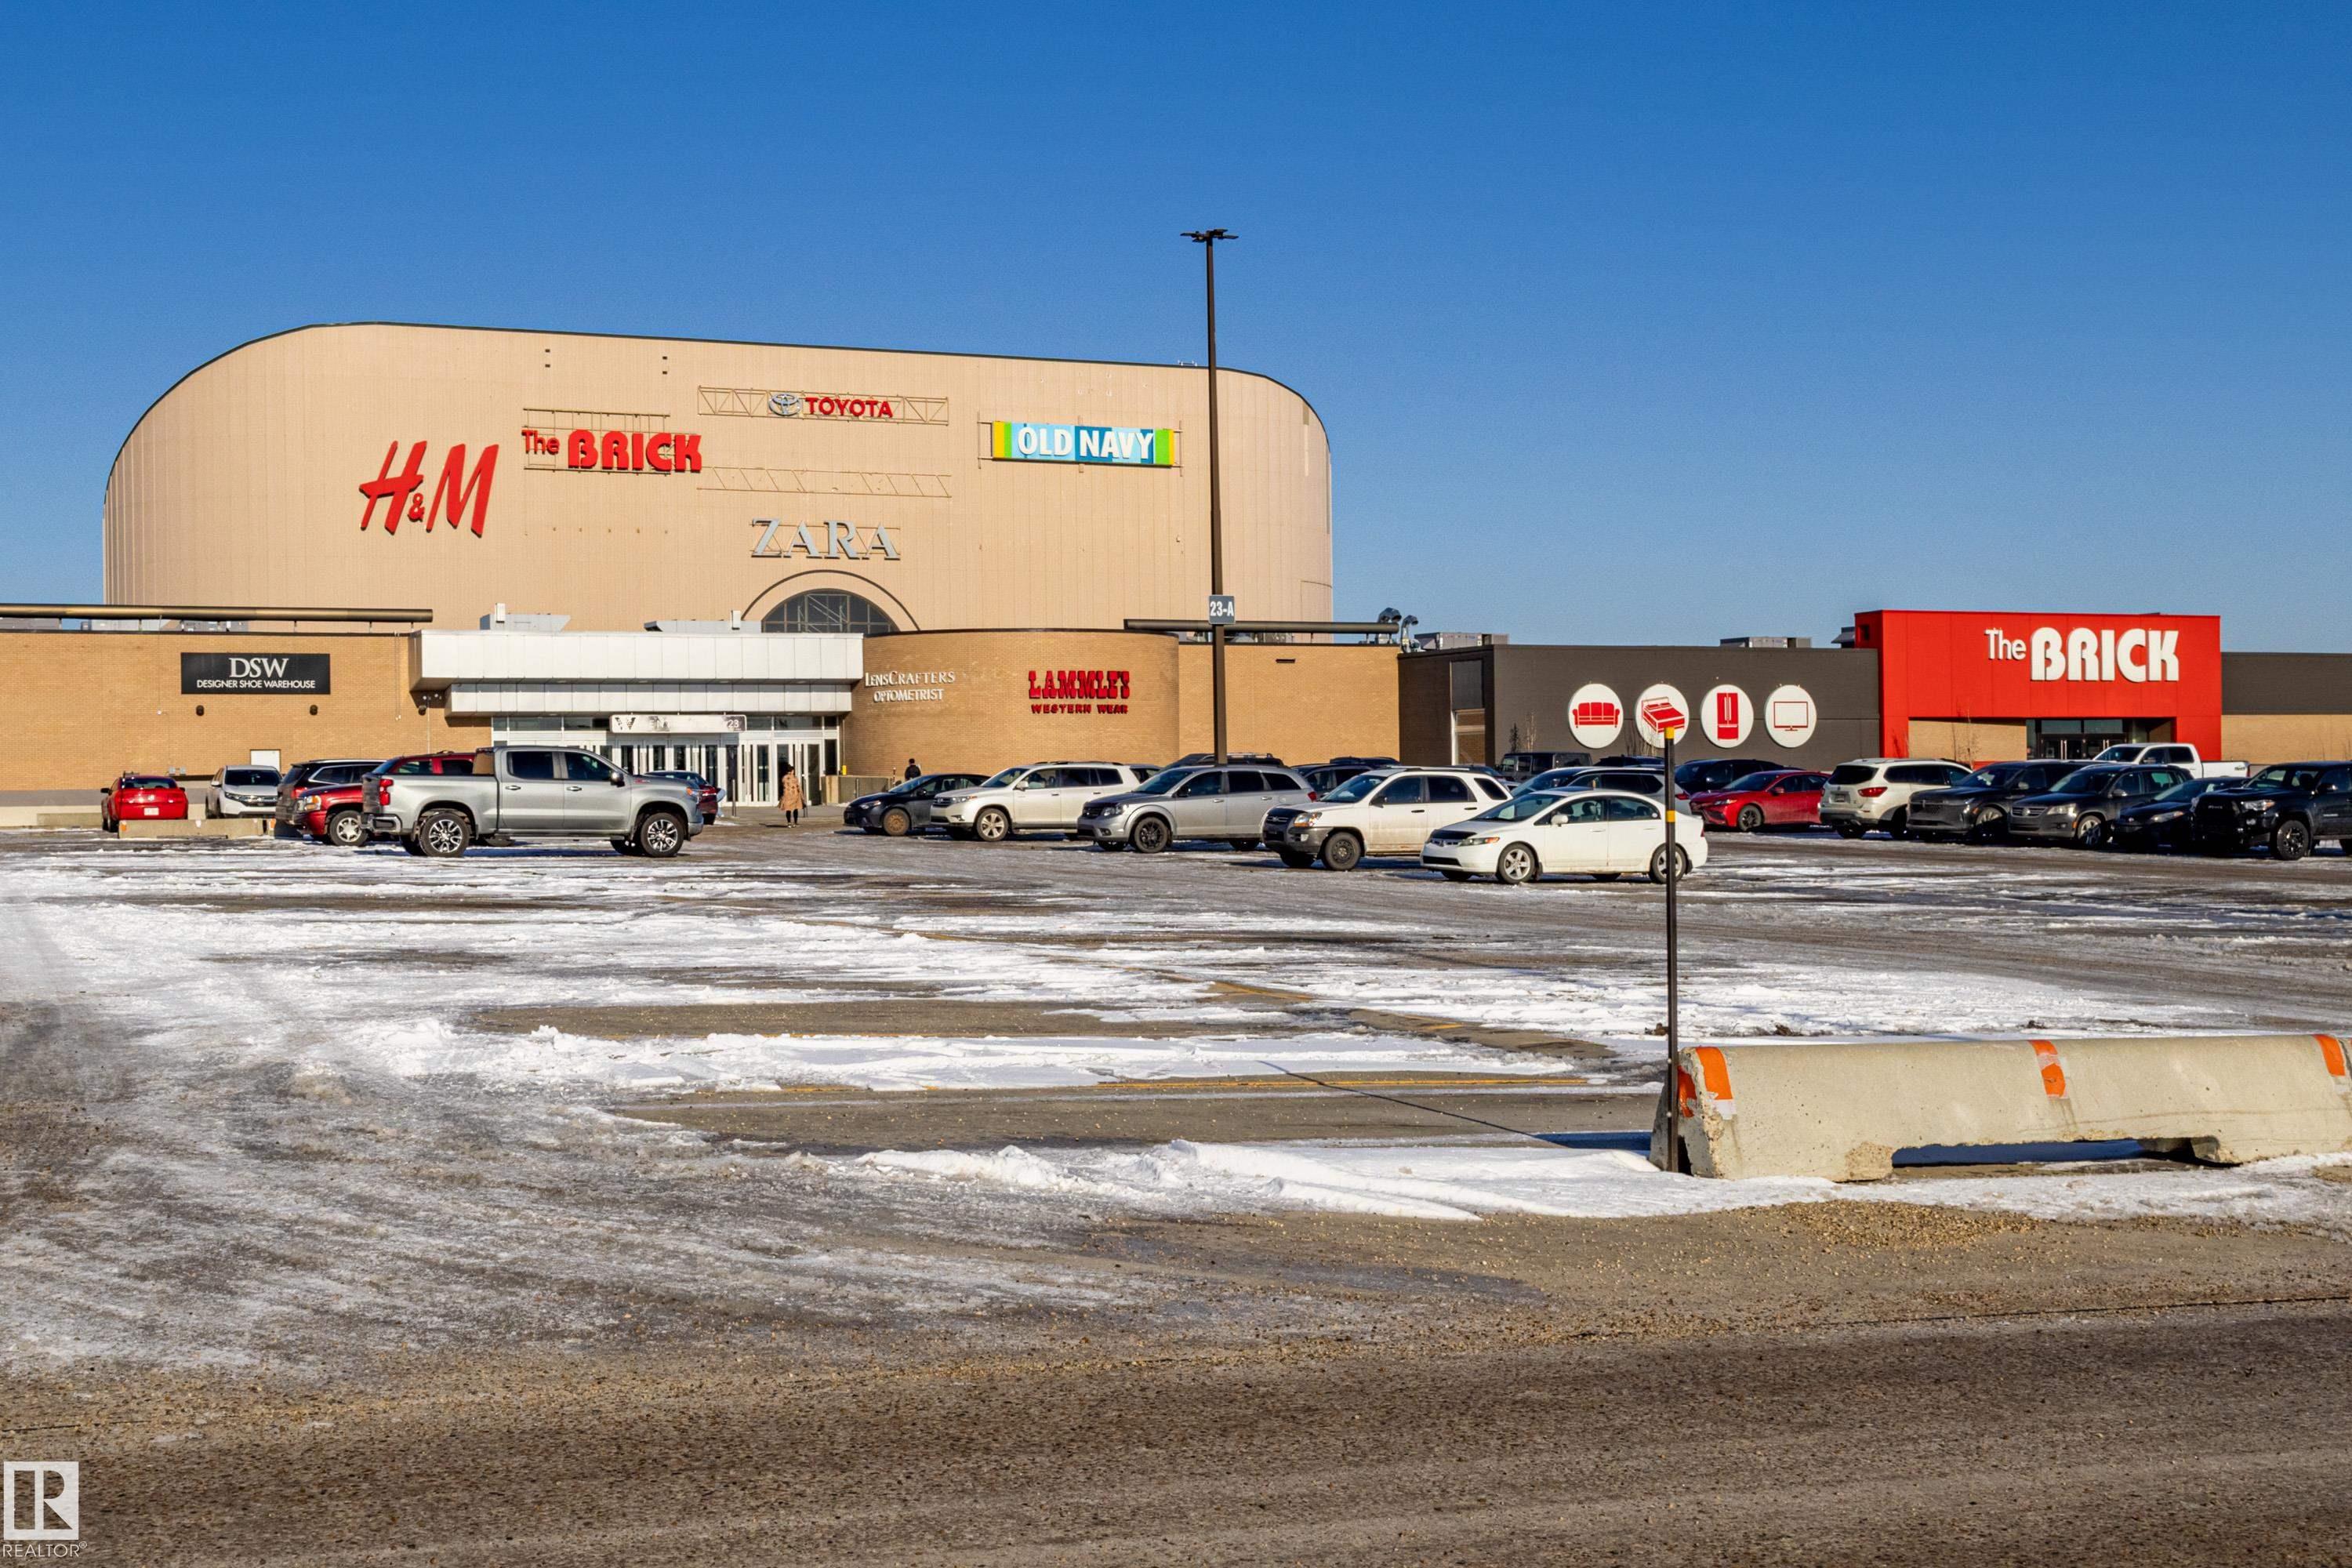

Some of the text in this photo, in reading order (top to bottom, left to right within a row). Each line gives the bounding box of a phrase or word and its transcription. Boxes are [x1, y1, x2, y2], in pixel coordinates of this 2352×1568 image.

[805, 397, 893, 418] TOYOTA
[521, 429, 702, 473] The BRICK
[1018, 426, 1155, 459] OLD NAVY
[359, 441, 499, 539] H&M
[750, 517, 901, 561] ZARA
[1210, 601, 1234, 617] 23-A
[1984, 626, 2180, 683] The BRICK
[228, 657, 289, 678] DSW
[197, 680, 316, 688] DESIGNER SHOE WAREHOUSE
[1028, 670, 1130, 699] LAMMLE'S
[873, 688, 945, 702] OPTOMETRIST
[1031, 704, 1128, 714] WESTERN WEAR
[728, 719, 740, 728] 23
